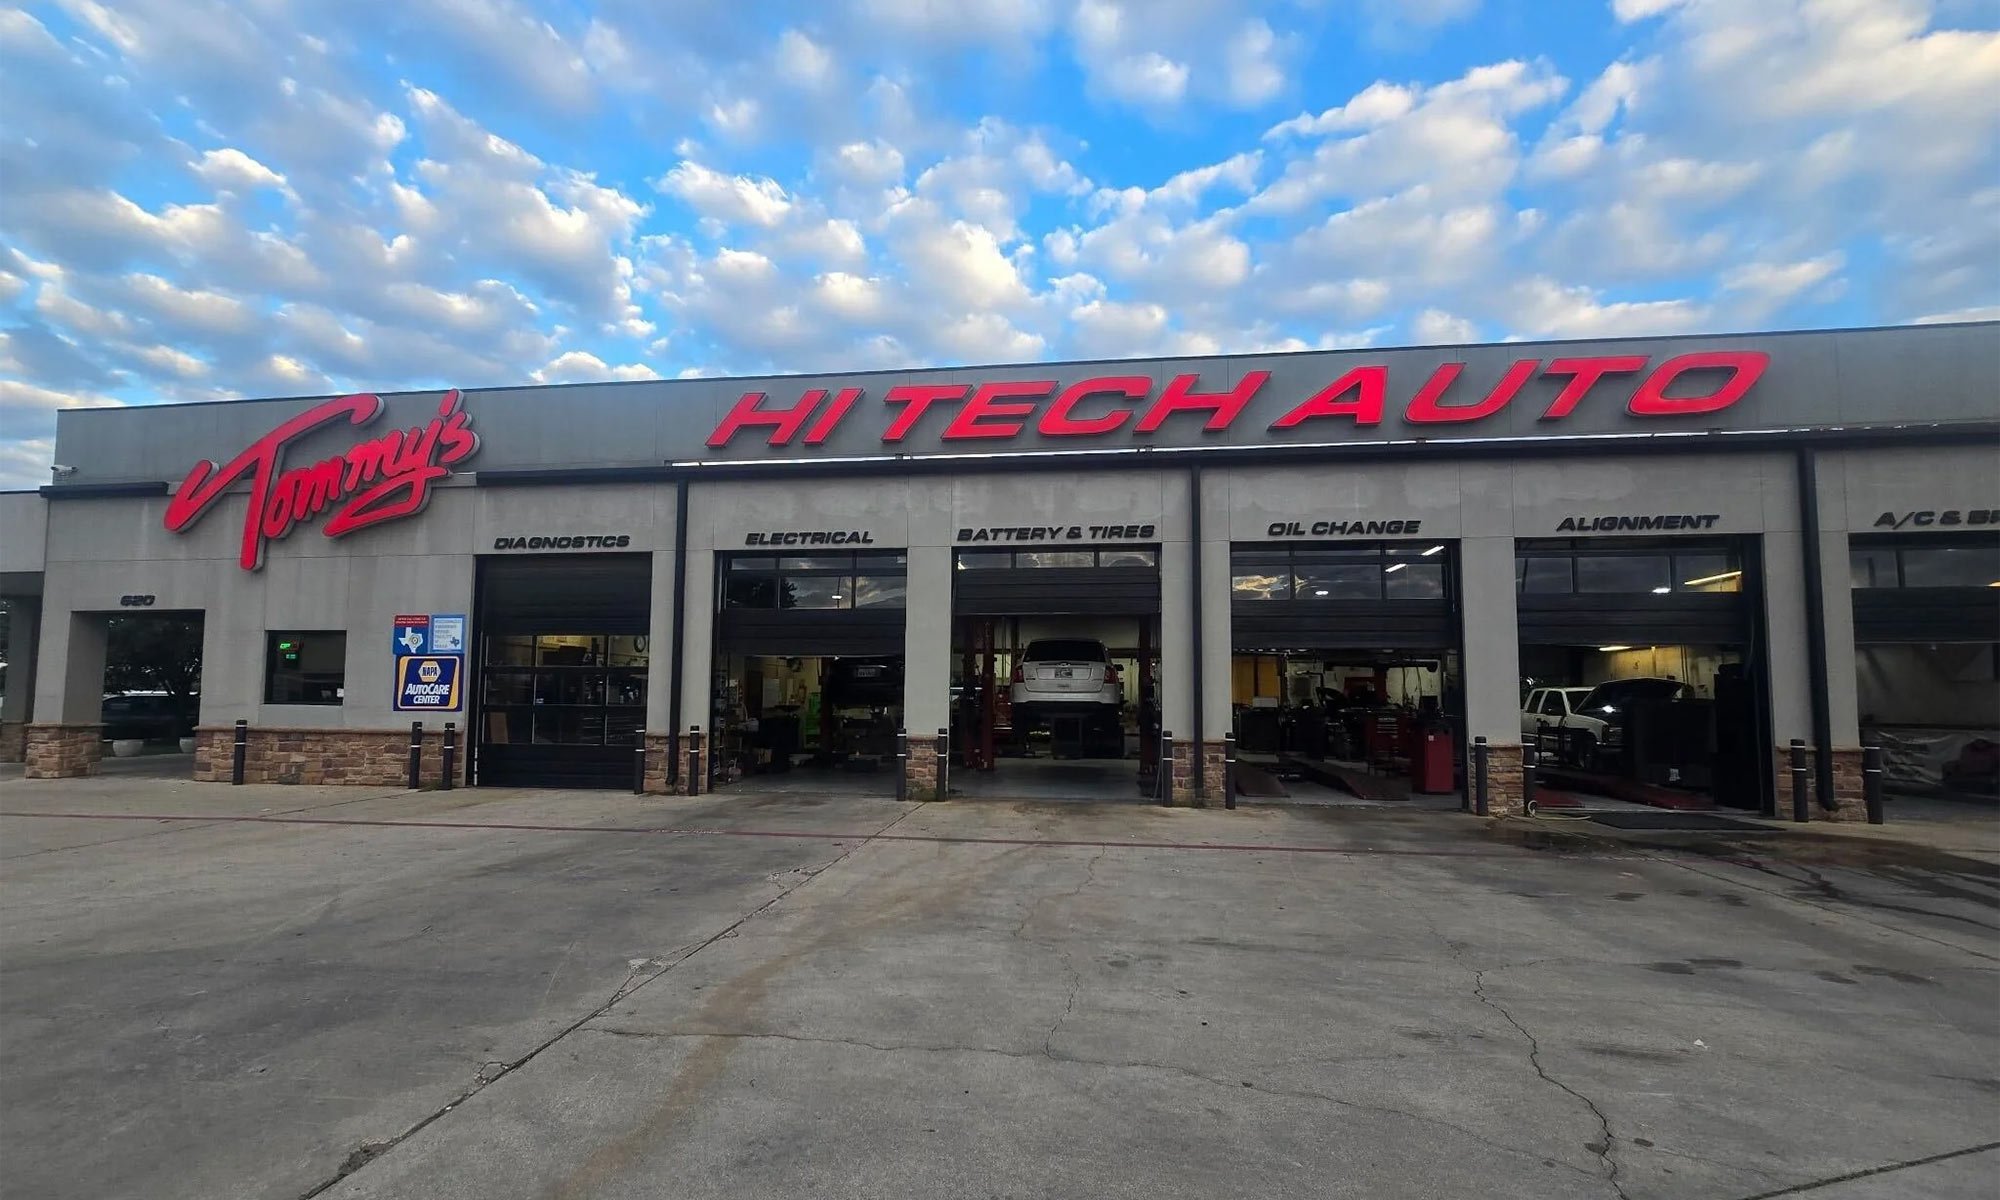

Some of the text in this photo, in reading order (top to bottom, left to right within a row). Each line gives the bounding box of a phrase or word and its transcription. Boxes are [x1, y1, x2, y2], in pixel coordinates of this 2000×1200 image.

[704, 350, 1770, 448] HI TECH AUTO
[163, 388, 480, 571] Tommy's
[1268, 520, 1422, 536] OIL CHANGE
[1556, 514, 1720, 532] ALIGNMENT
[1873, 510, 1935, 530] A/C
[745, 531, 874, 545] ELECTRICAL
[957, 525, 1155, 542] BATTERY & TIRES
[494, 535, 630, 550] DIAGNOSTICS
[421, 666, 438, 677] NAPA
[413, 695, 440, 704] CENTER
